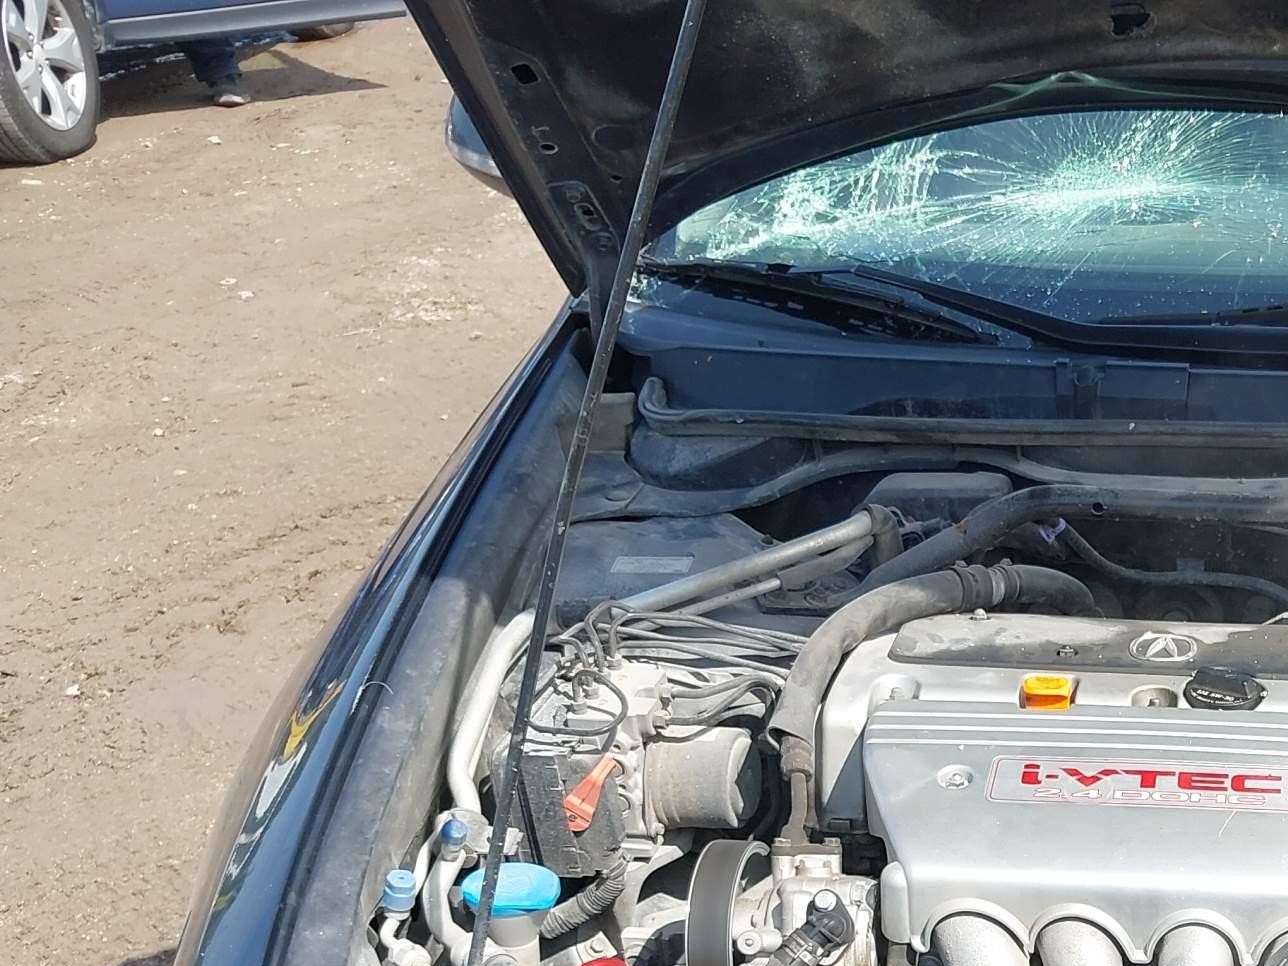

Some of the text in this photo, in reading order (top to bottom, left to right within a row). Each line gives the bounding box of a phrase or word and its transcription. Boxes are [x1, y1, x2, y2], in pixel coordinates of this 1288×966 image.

[1020, 762, 1282, 794] i-VTEC
[1032, 787, 1267, 806] 2.4 DOHC
